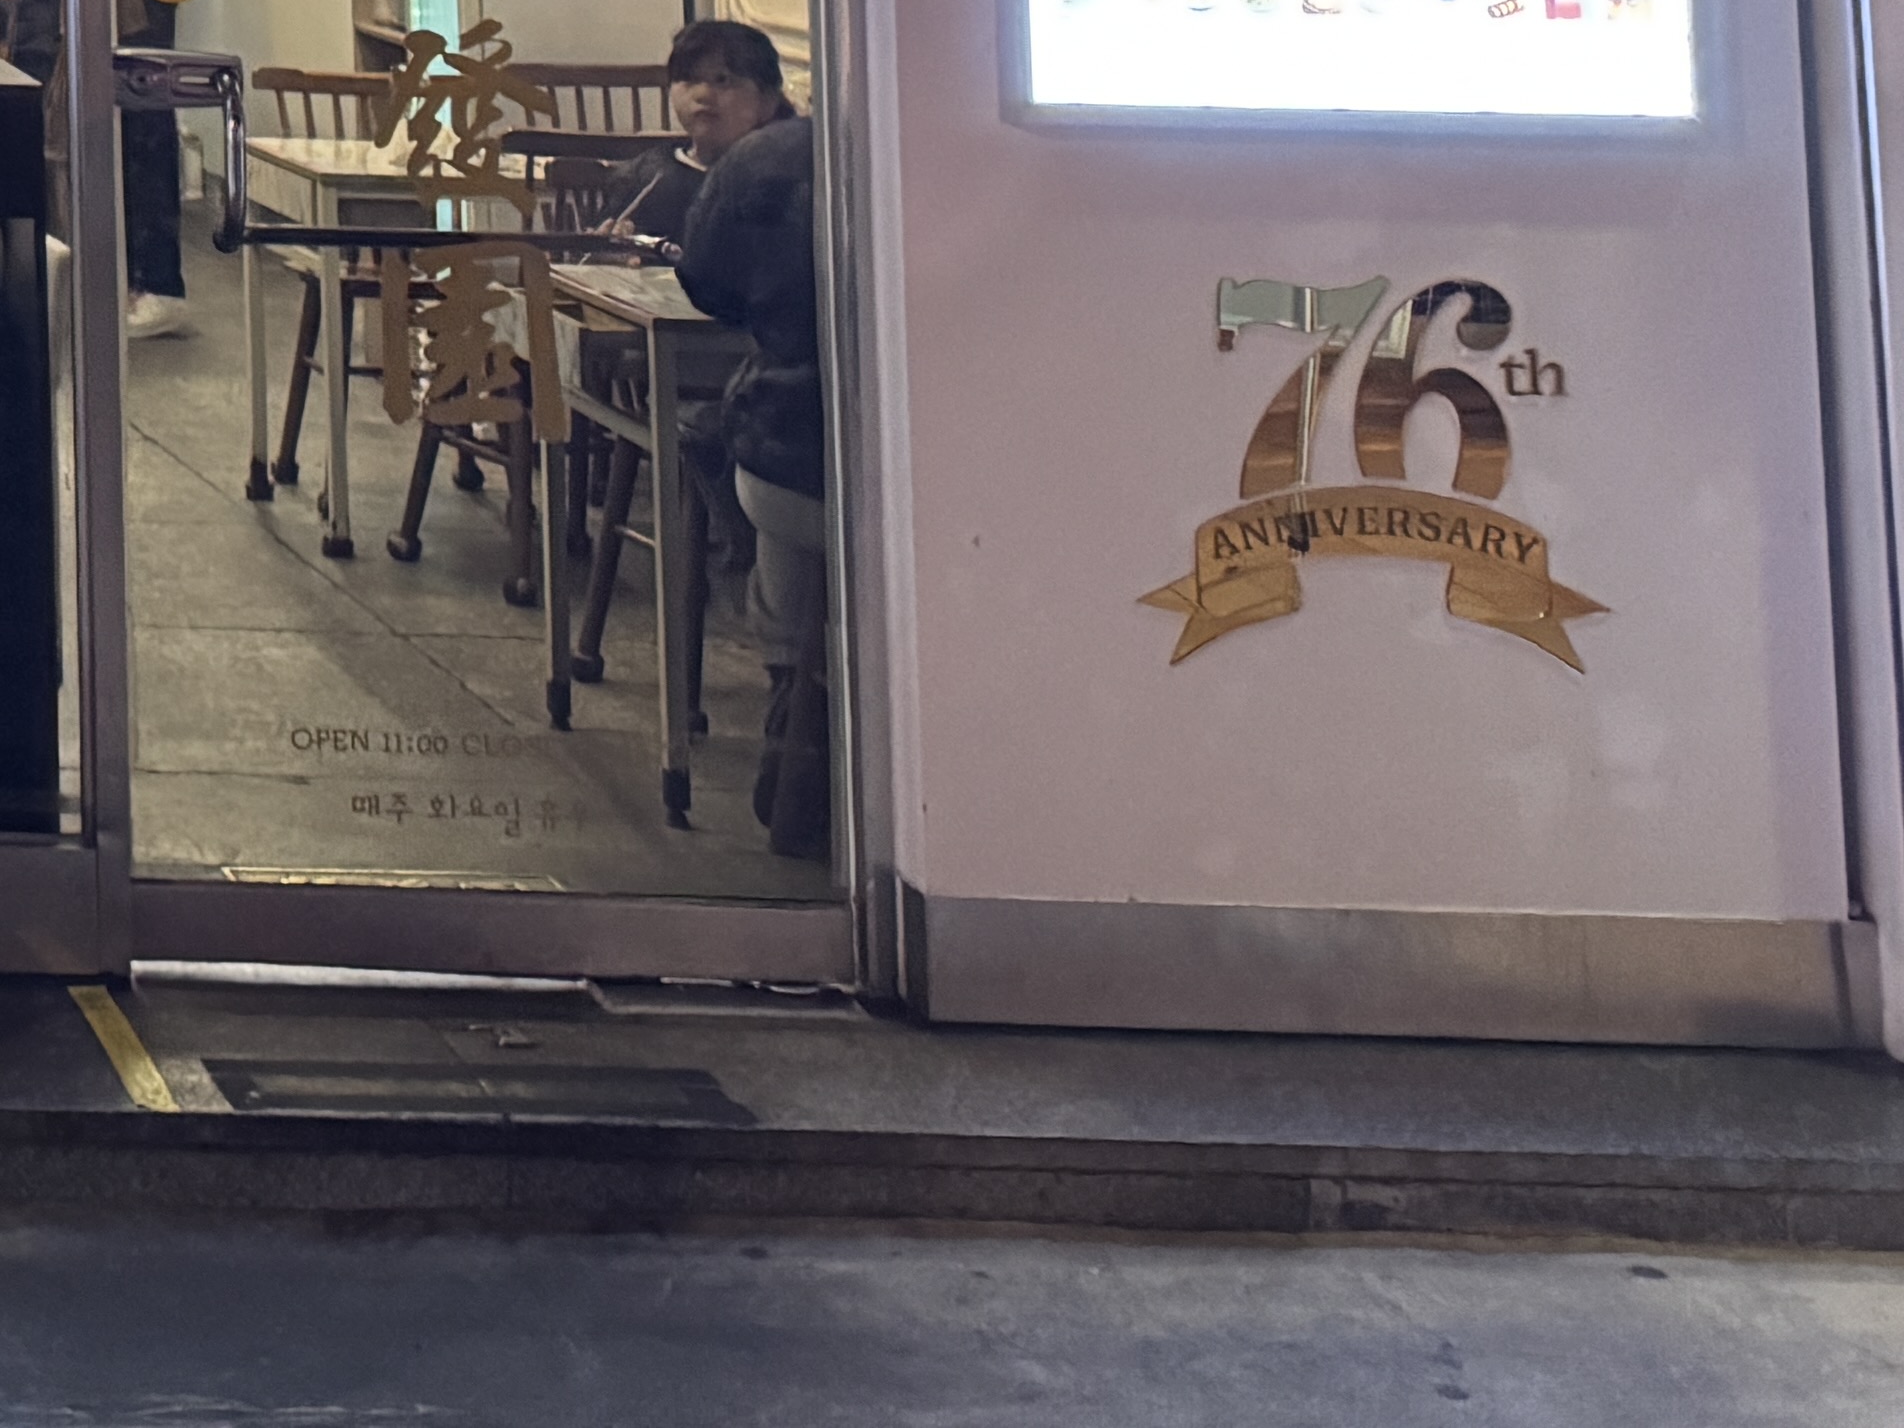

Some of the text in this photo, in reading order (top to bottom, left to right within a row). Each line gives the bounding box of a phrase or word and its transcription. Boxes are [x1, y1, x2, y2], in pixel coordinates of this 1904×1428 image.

[290, 728, 370, 753] OPEN
[381, 732, 449, 755] 11:00
[350, 793, 413, 825] 매주
[426, 792, 522, 838] 화요일
